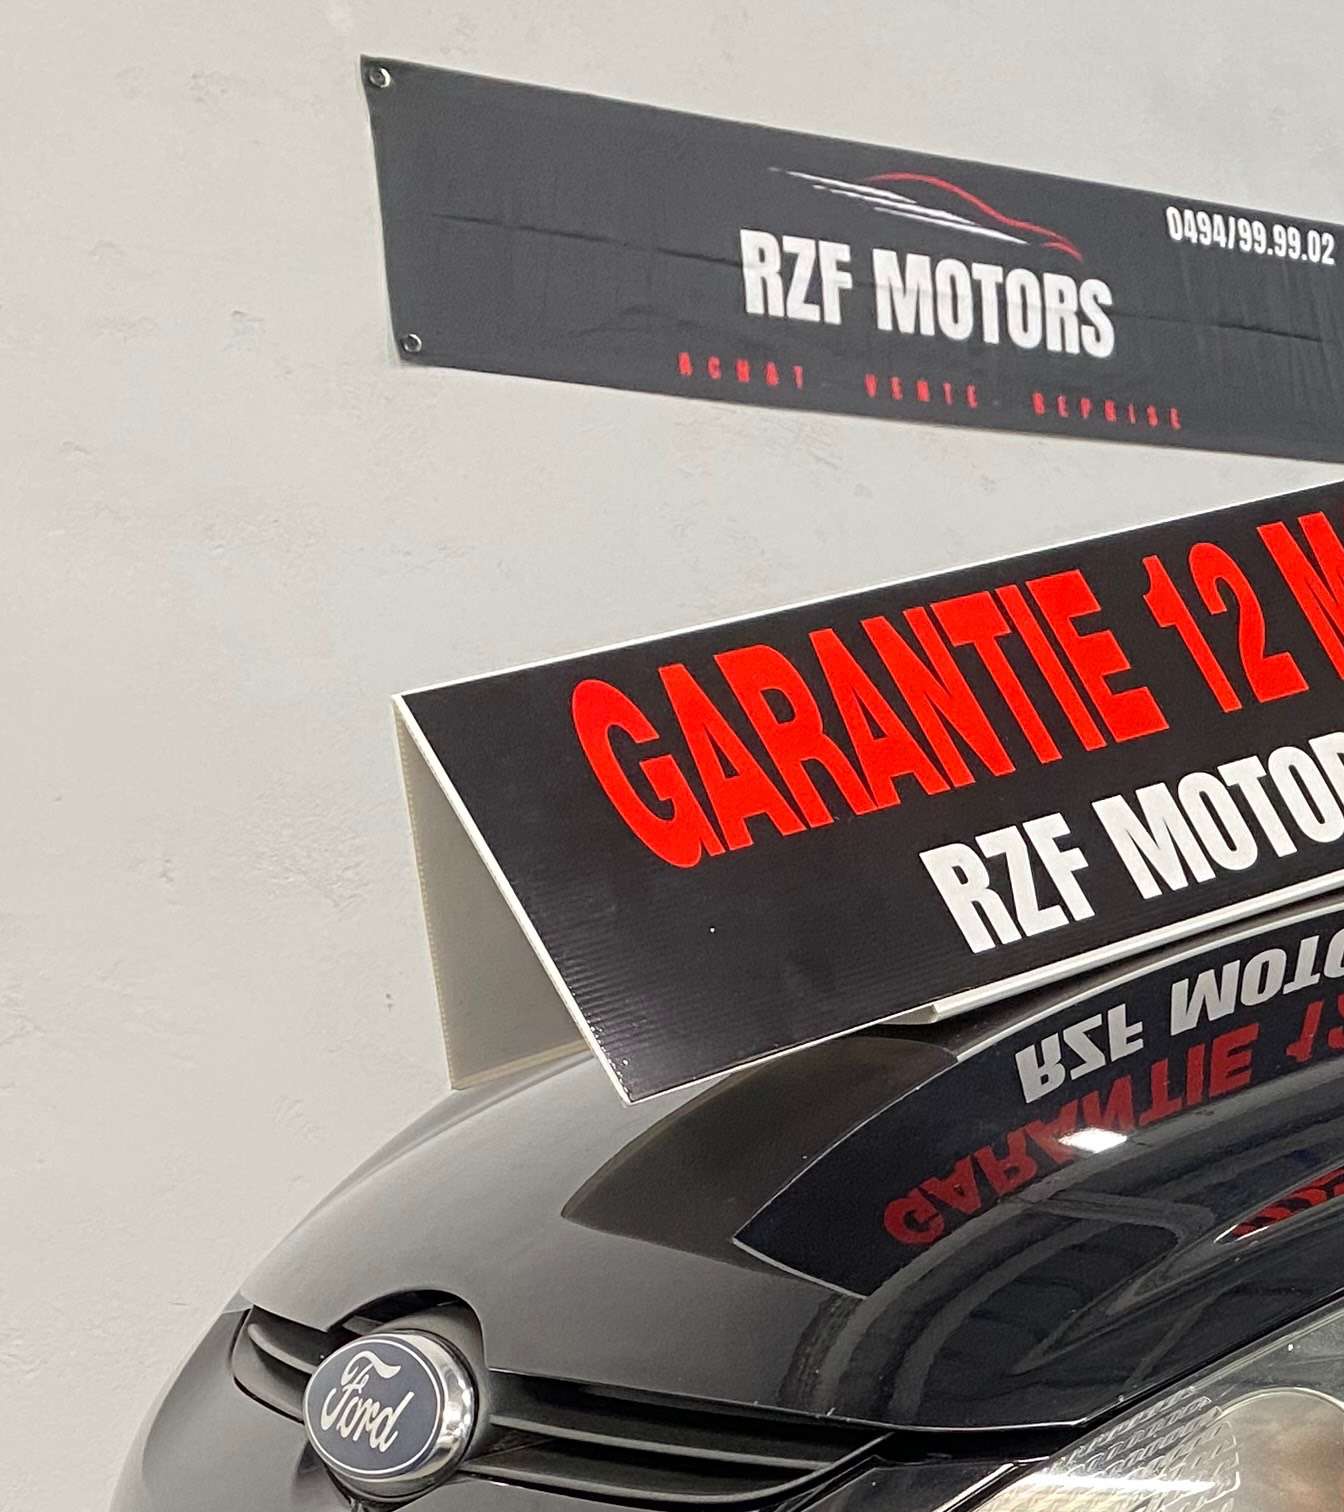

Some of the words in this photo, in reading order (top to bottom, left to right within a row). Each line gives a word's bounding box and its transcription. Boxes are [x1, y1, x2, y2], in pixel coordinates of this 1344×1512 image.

[739, 228, 853, 326] RZF
[871, 246, 1116, 359] MOTORS
[1165, 205, 1337, 266] 0494/99.99.02
[570, 567, 1168, 869] GARANTIE
[1142, 541, 1309, 713] 12
[918, 811, 1095, 954] RZF
[320, 1350, 415, 1453] Ford
